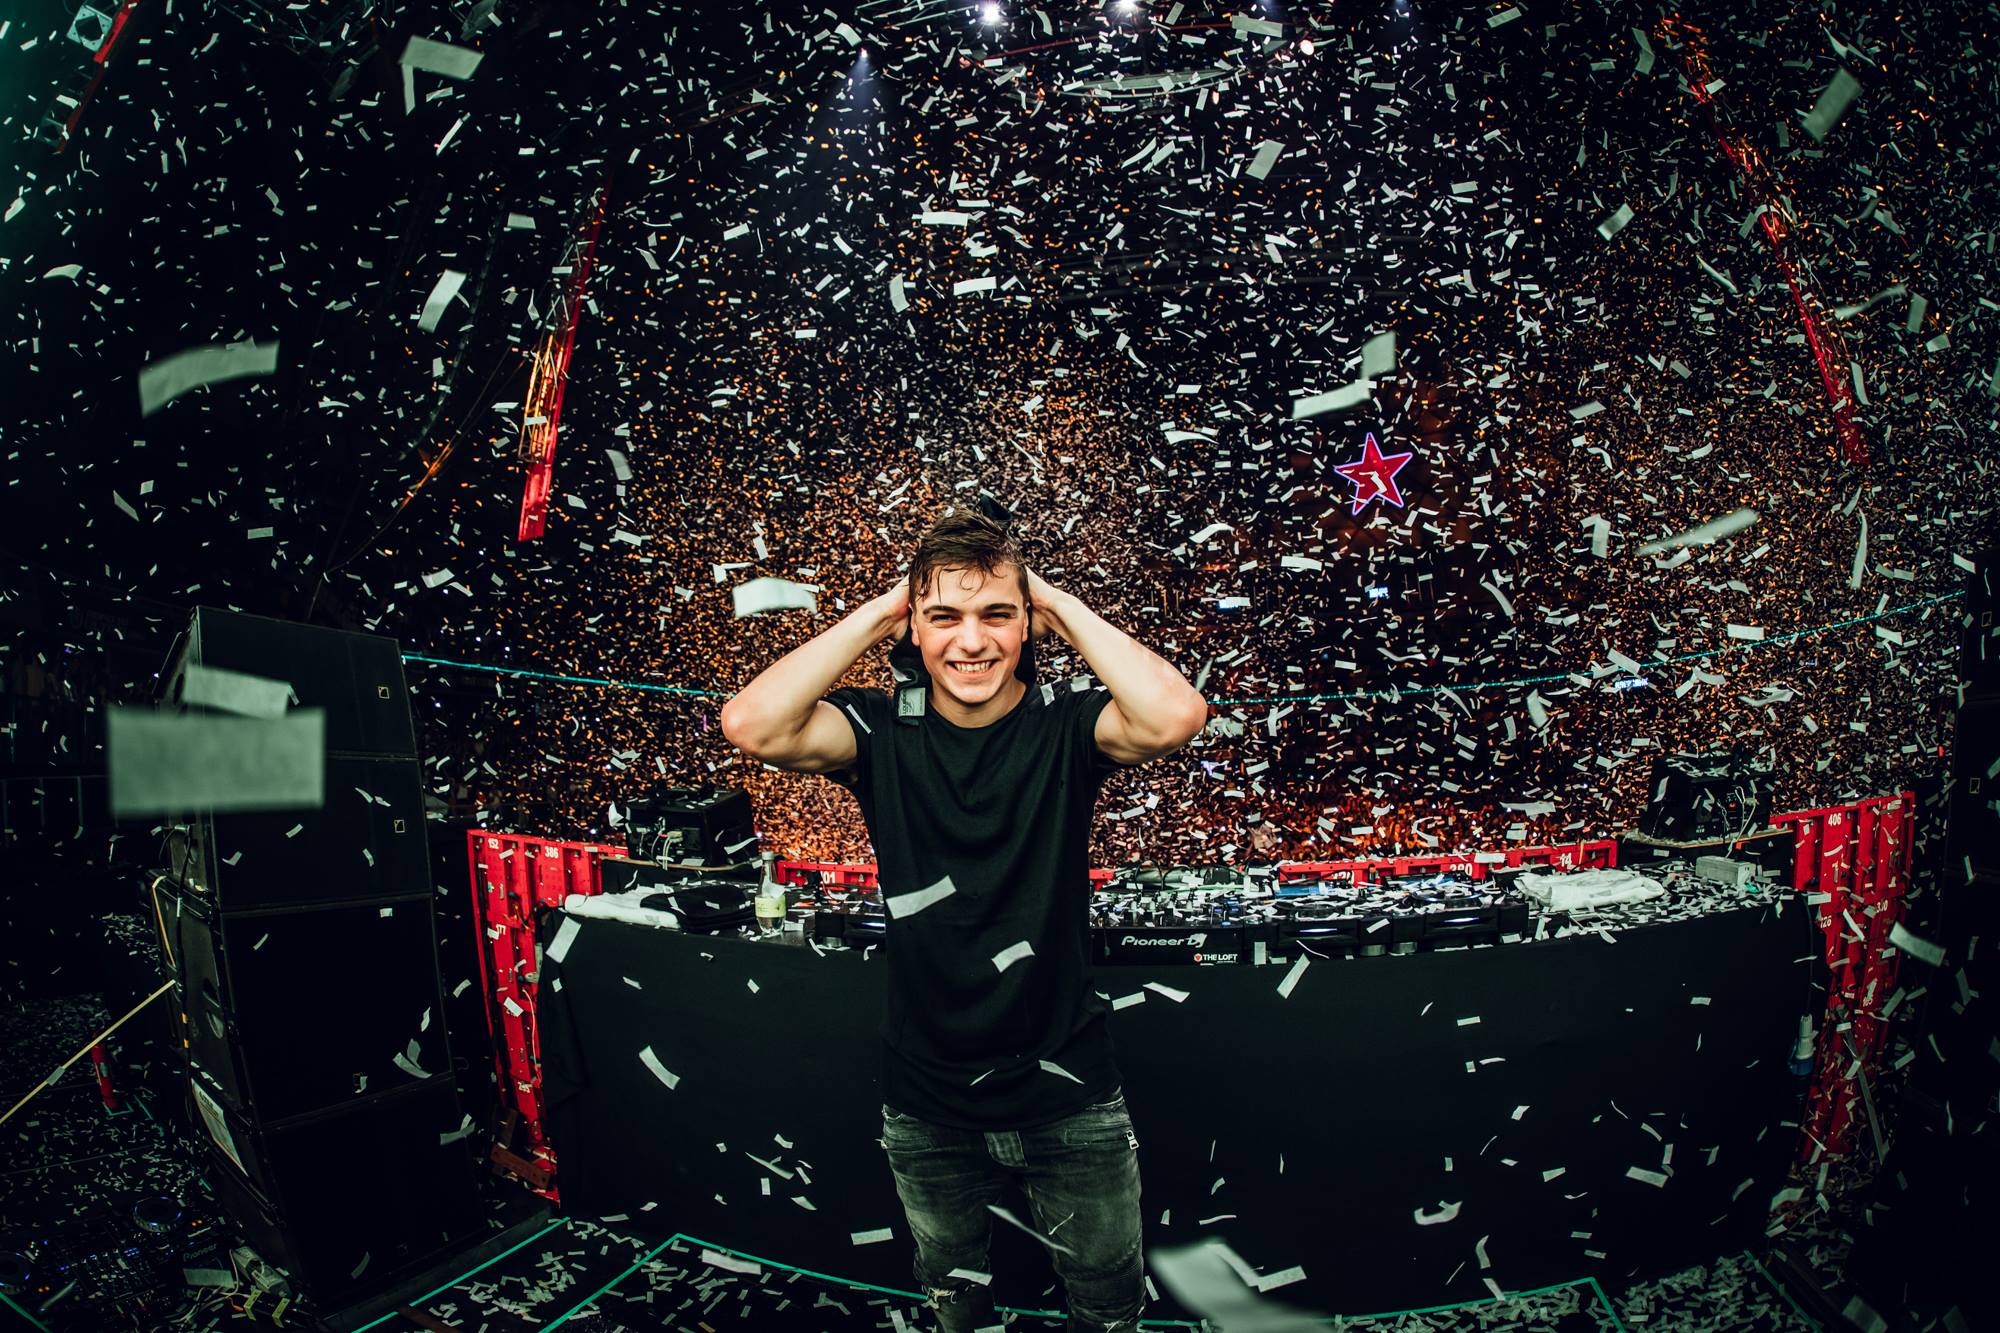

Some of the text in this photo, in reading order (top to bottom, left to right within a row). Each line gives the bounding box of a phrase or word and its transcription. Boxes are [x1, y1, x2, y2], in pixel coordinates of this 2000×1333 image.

[1828, 813, 1842, 826] 406
[545, 846, 559, 859] 386
[820, 870, 836, 884] 01
[1121, 933, 1208, 948] Pioneer DJ
[1203, 953, 1239, 961] THE LOFT
[183, 1243, 217, 1262] Pioneer
